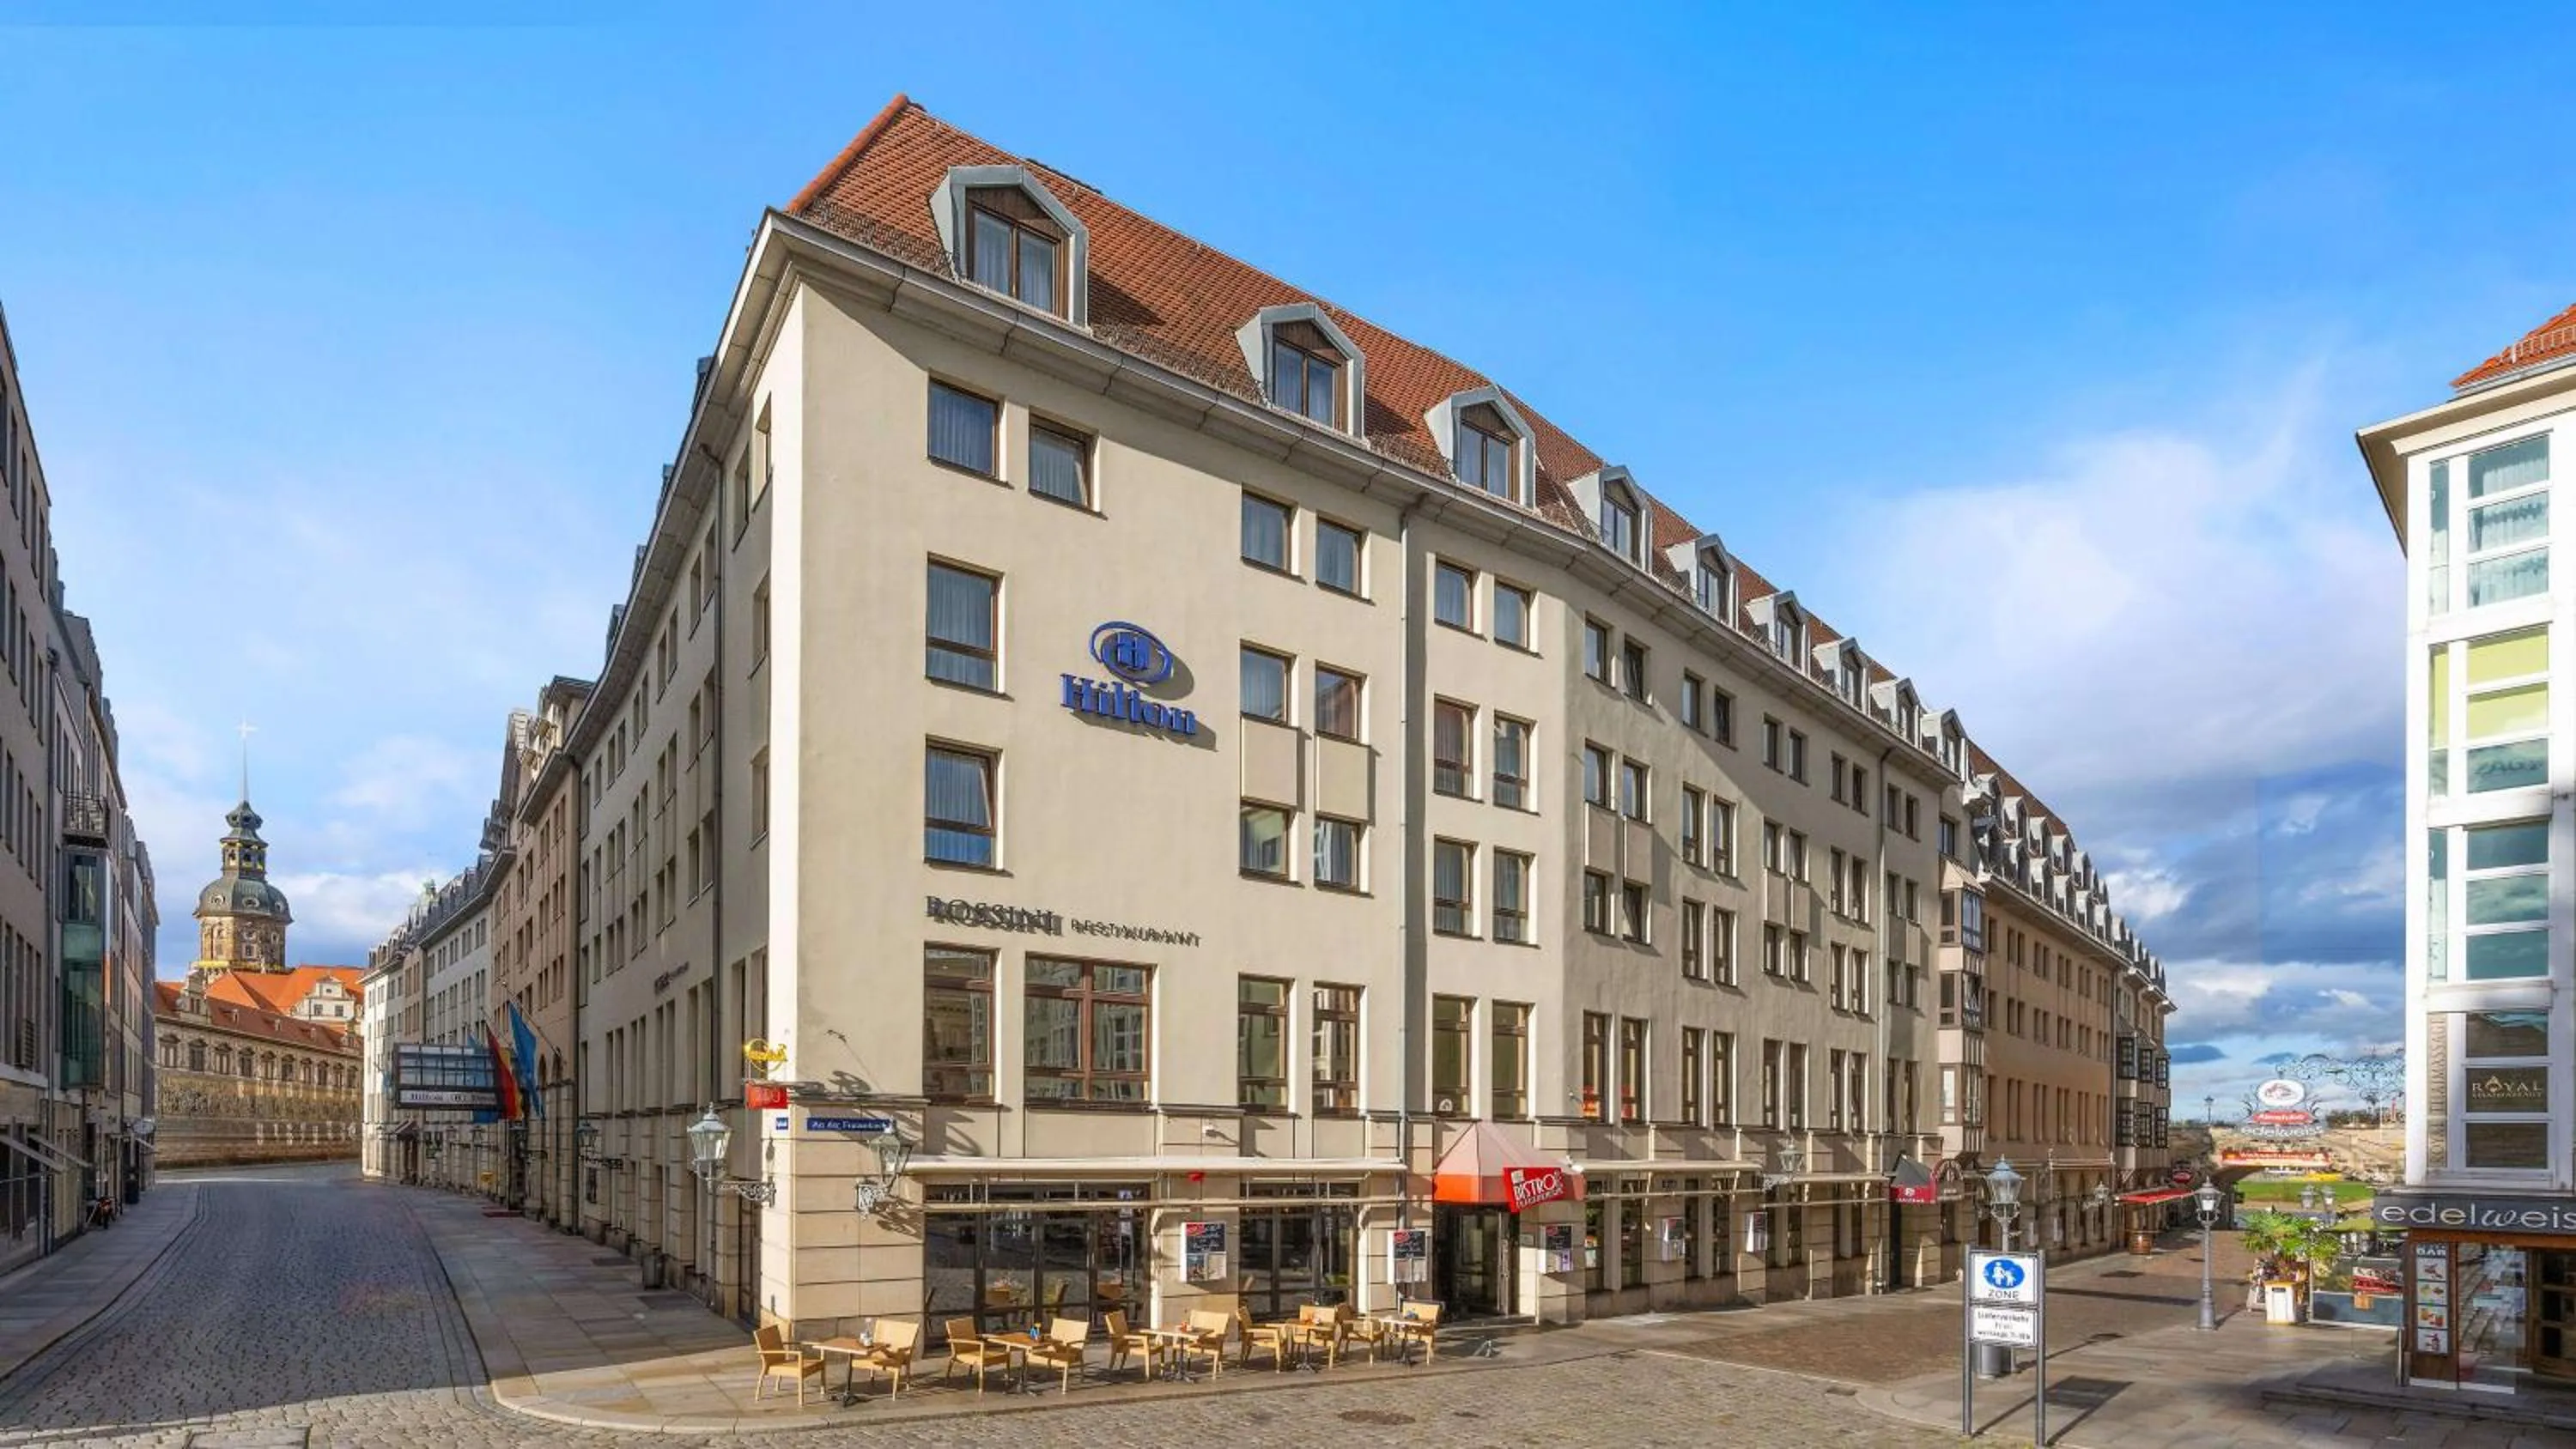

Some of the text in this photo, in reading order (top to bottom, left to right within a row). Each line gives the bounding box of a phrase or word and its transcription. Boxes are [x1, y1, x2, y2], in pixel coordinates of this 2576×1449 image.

[1060, 673, 1196, 735] Hilton
[926, 895, 1201, 948] ROSSINI RESTAURANT
[2472, 1076, 2543, 1094] ROYAL
[1513, 1173, 1555, 1201] BISTRO
[1989, 1289, 2020, 1299] ZONE
